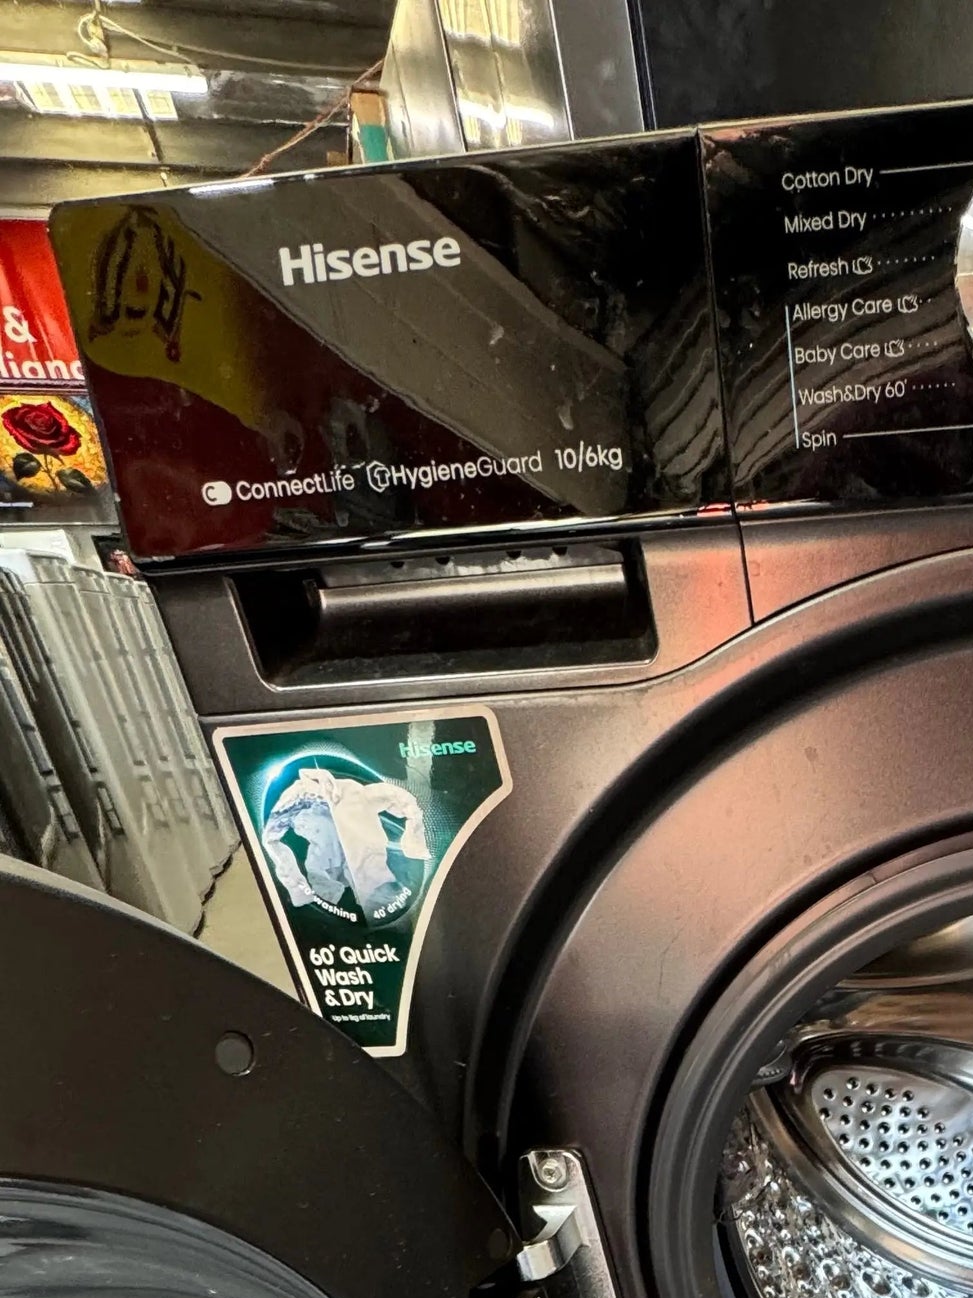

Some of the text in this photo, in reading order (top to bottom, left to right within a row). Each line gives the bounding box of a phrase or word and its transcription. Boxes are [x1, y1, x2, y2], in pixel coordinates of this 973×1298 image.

[781, 166, 873, 191] Cotton Dry
[784, 210, 867, 234] Mixed Dry
[278, 236, 461, 287] Hisense
[788, 257, 849, 280] Refresh
[792, 298, 893, 322] Allergy Care
[3, 305, 37, 343] &
[794, 343, 881, 365] Baby Care
[798, 384, 882, 406] Wash&Dry
[801, 429, 837, 451] Spin
[235, 440, 623, 501] ConnectLife HygieneGuard 10/6kg
[398, 740, 477, 759] Hisense
[386, 885, 413, 912] drying
[339, 942, 400, 965] Quick
[314, 967, 373, 987] Wash
[324, 988, 374, 1010] & Dry
